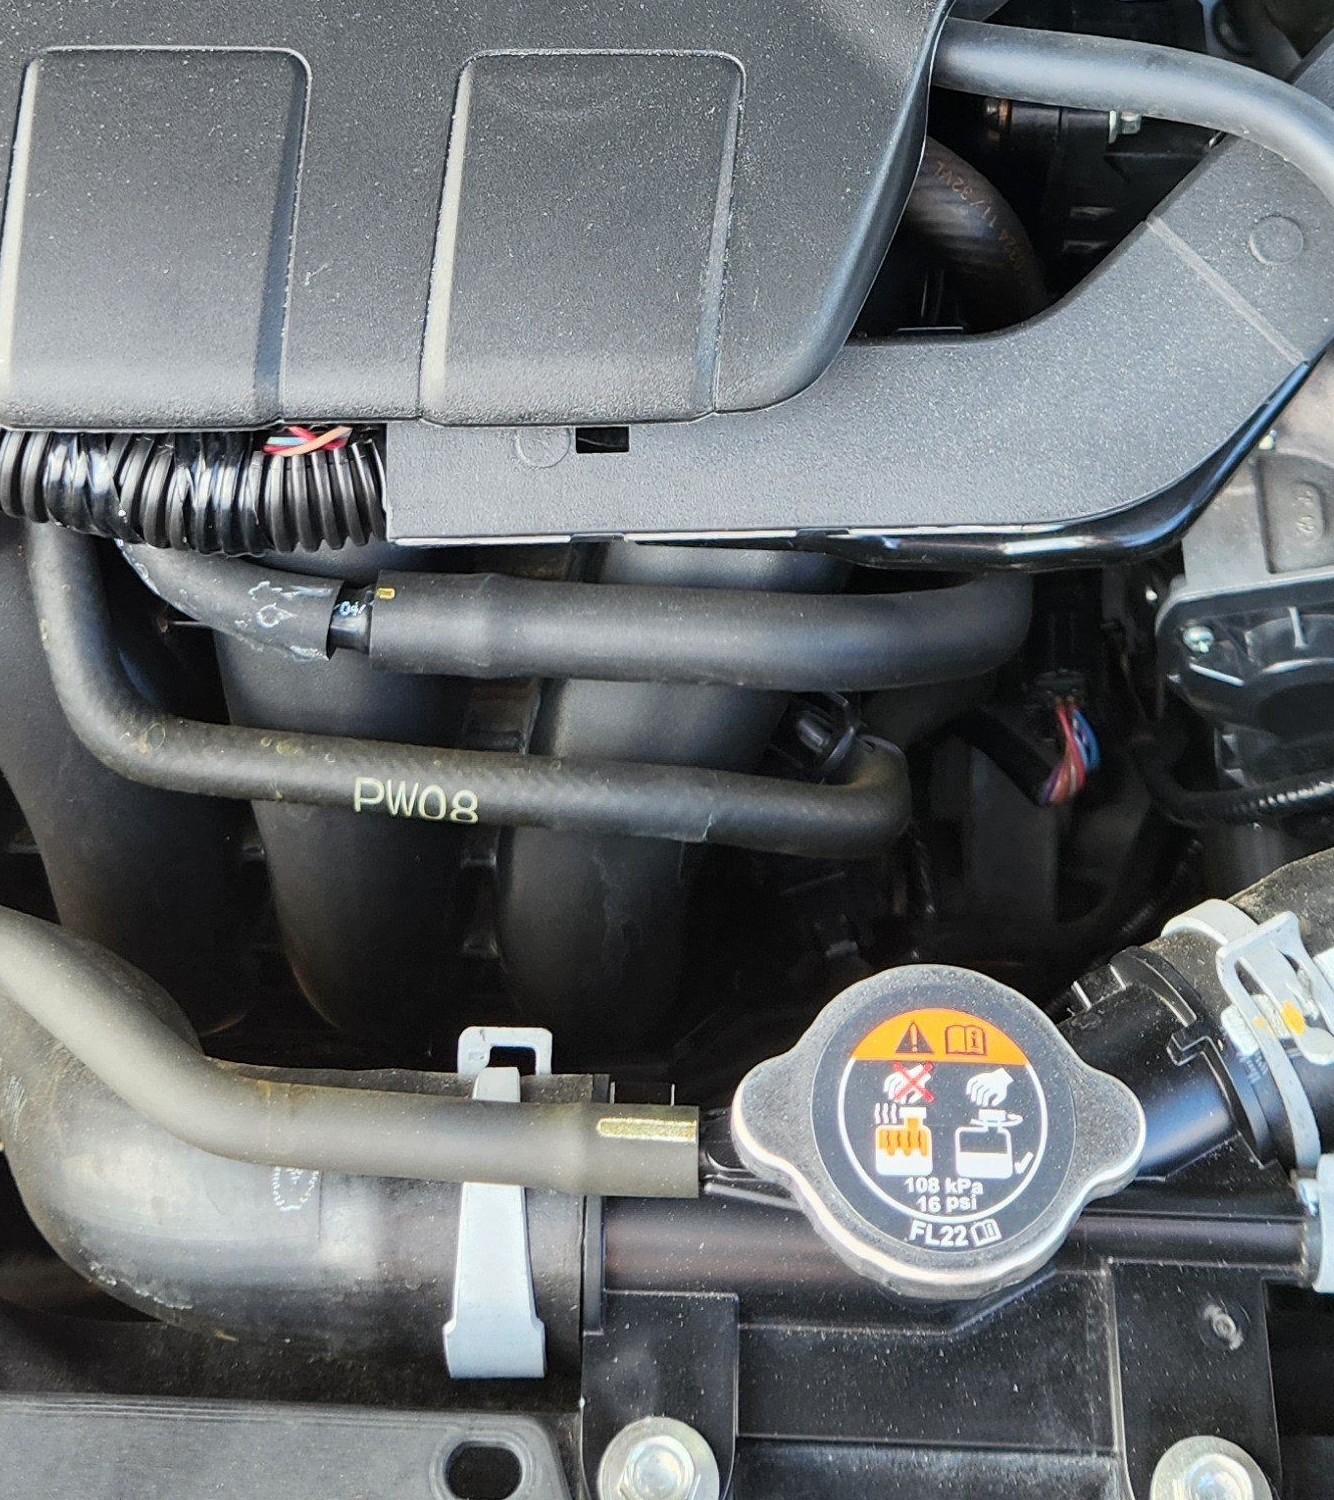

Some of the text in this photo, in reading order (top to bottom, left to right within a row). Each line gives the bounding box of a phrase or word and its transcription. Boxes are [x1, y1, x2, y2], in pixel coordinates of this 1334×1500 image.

[353, 776, 479, 824] PW08
[903, 1177, 984, 1195] 108 kPa
[915, 1192, 978, 1213] 16 psi
[908, 1220, 969, 1246] FL22
